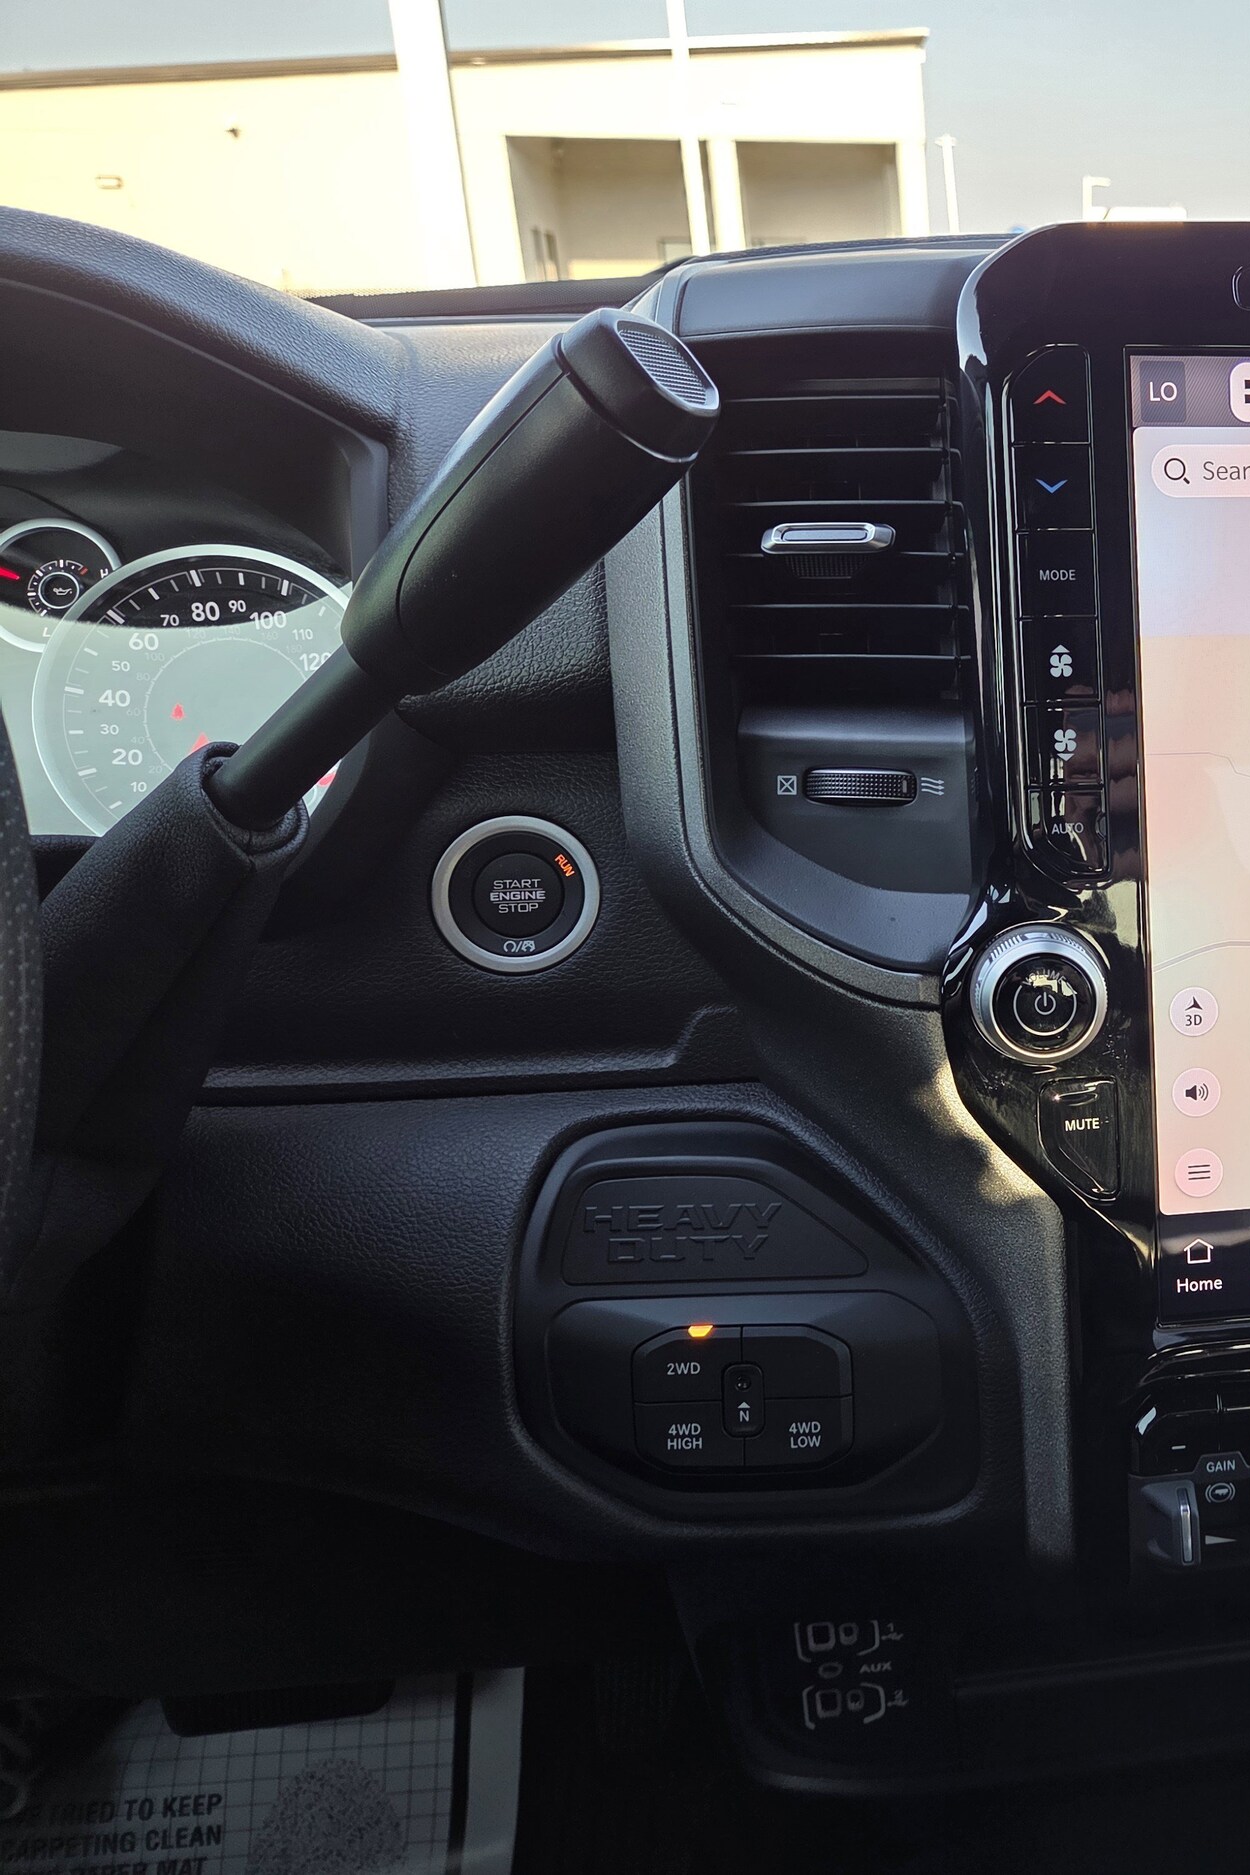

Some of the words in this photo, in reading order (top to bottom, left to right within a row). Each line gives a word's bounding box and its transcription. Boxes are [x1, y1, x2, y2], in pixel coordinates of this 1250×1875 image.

[1149, 382, 1178, 402] LO
[1039, 569, 1076, 581] MODE
[190, 601, 220, 622] 80
[228, 600, 247, 613] 90
[160, 614, 180, 627] 70
[250, 610, 287, 630] 100
[292, 628, 314, 641] 110
[128, 633, 159, 652] 60
[111, 660, 130, 673] 50
[98, 690, 130, 707] 40
[100, 724, 119, 735] 30
[111, 748, 143, 765] 20
[130, 781, 147, 792] 10
[1051, 823, 1084, 835] AUTO
[554, 853, 575, 877] RUN
[493, 878, 541, 889] START
[490, 890, 546, 901] ENGINE
[498, 902, 539, 913] STOP
[1185, 1014, 1203, 1026] 3D
[1064, 1118, 1100, 1132] MUTE
[583, 1202, 782, 1233] HEAVY
[607, 1234, 769, 1263] DUTY
[1176, 1277, 1223, 1293] Home
[666, 1362, 700, 1375] 2WD
[739, 1410, 750, 1422] N
[668, 1423, 701, 1436] 4WD
[789, 1421, 821, 1435] 4WD
[667, 1437, 702, 1450] HIGH
[790, 1435, 821, 1449] LOW
[1206, 1460, 1236, 1473] GAIN
[859, 1661, 893, 1674] AUX
[124, 1798, 154, 1822] TO
[162, 1793, 223, 1818] KEEP
[145, 1824, 222, 1852] CLEAN
